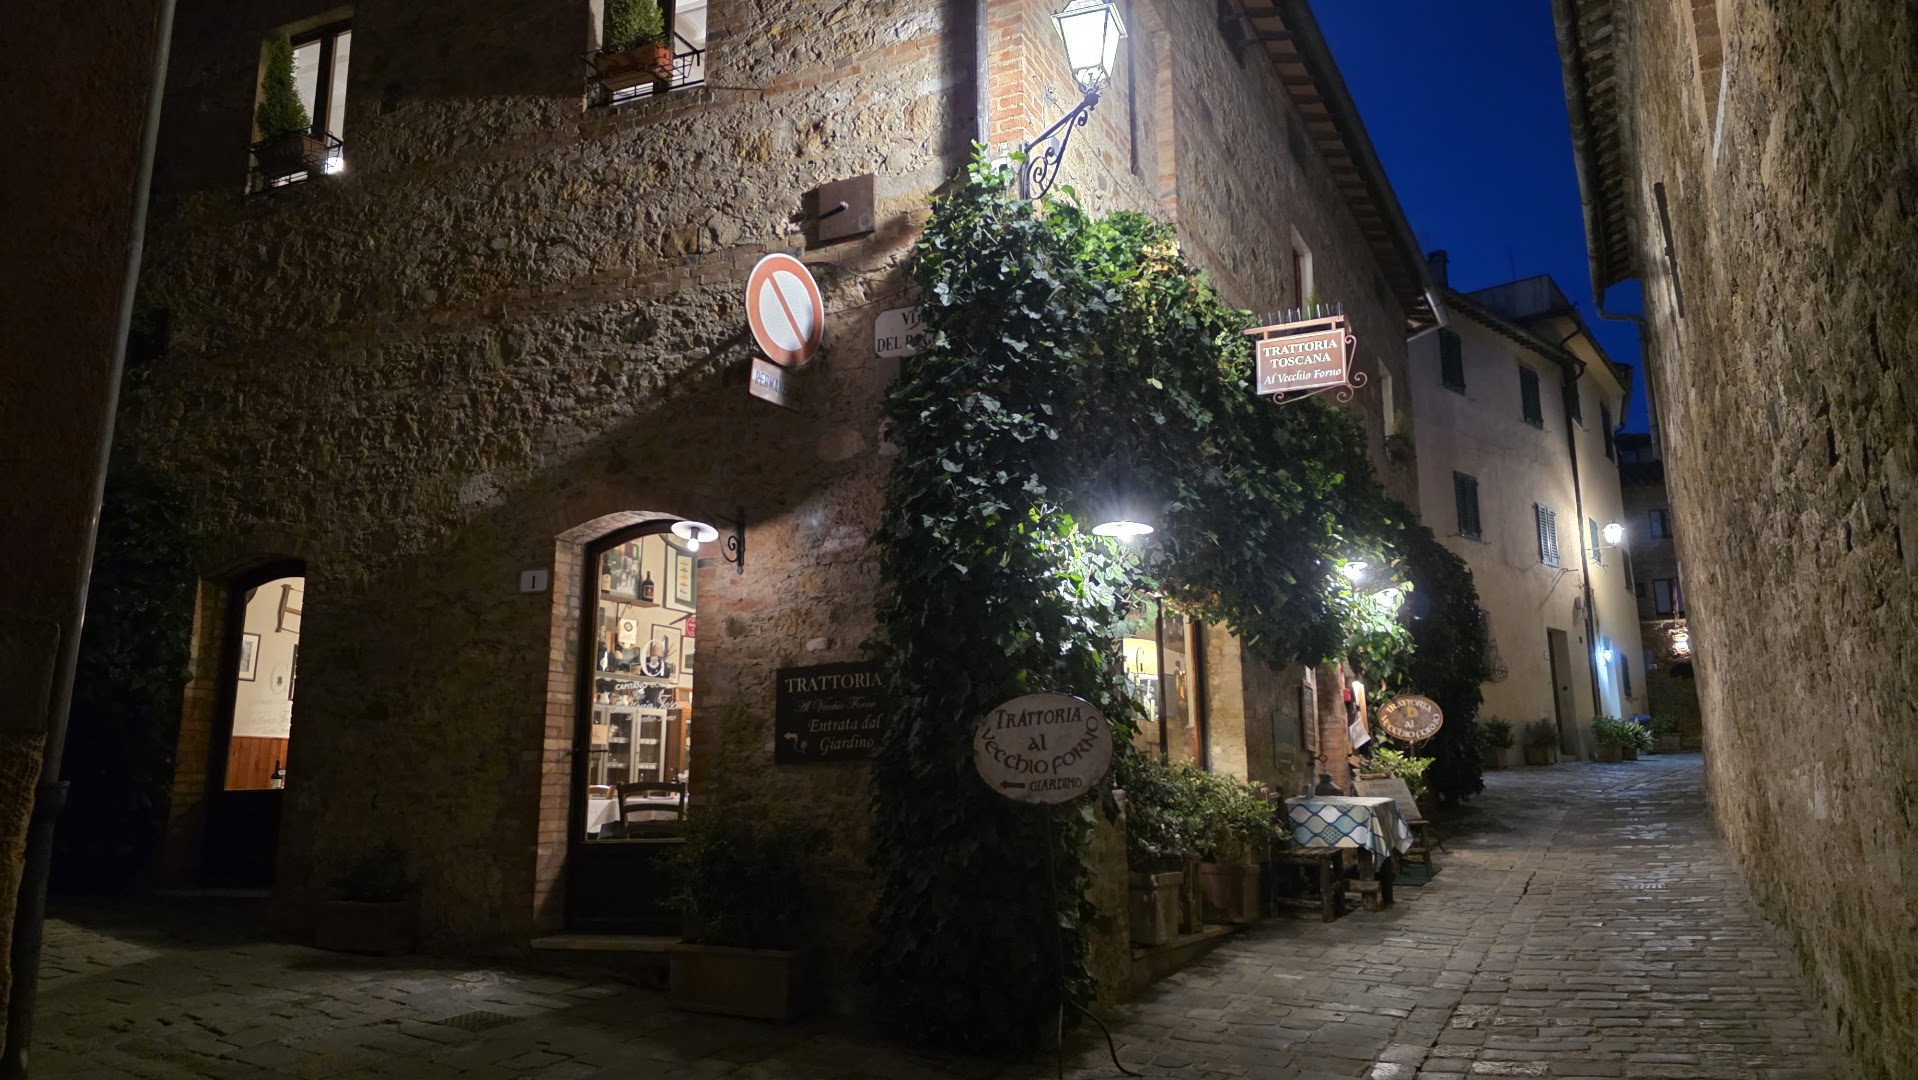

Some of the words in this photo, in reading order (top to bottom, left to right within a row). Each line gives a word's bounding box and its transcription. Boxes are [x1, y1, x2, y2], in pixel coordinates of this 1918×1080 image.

[877, 336, 902, 352] DEL
[1263, 338, 1338, 357] TRATTORIA
[1270, 352, 1332, 368] TOSCANA
[1263, 373, 1277, 385] Al
[1278, 370, 1311, 383] Vecchio
[1313, 368, 1342, 379] Forno
[615, 682, 648, 691] CAPITANO
[785, 672, 883, 693] TRATTORIA
[1386, 699, 1432, 713] TRATTORIA
[808, 718, 858, 733] Entrata
[861, 713, 884, 729] dal
[994, 707, 1082, 729] TRATTORIA
[820, 734, 874, 756] Giardino
[1029, 777, 1082, 792] GIARDINO
